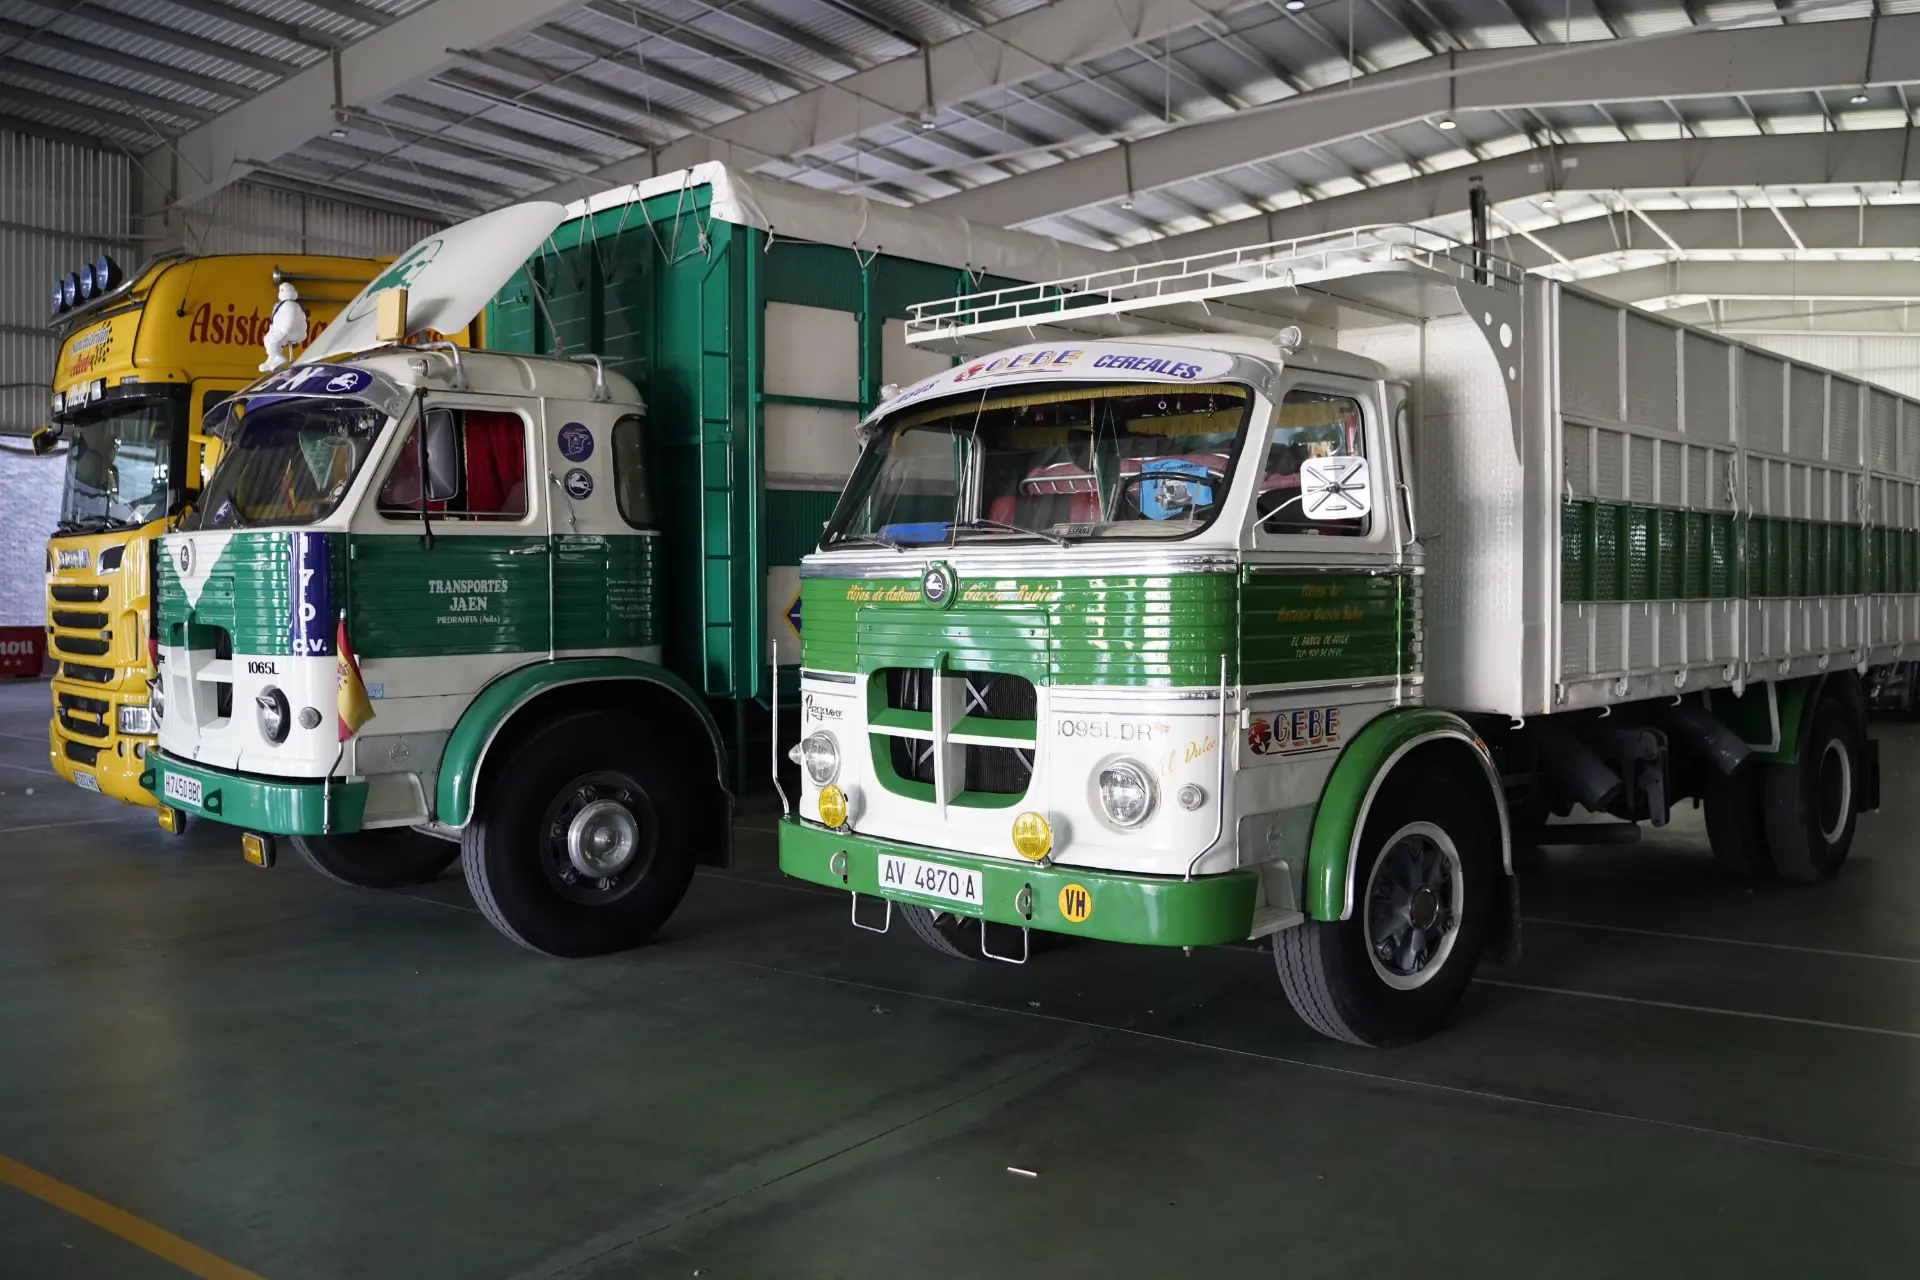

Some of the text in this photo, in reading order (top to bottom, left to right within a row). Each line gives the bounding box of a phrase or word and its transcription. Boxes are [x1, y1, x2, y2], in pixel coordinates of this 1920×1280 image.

[189, 302, 328, 349] Asisteia
[1093, 354, 1203, 380] CEREALES
[428, 579, 508, 594] TRANSPORTES
[846, 584, 870, 603] Hijos
[872, 585, 883, 601] de
[885, 584, 921, 602] Antonio
[450, 596, 488, 611] JAEN
[436, 615, 478, 624] PIEDRAHITA
[247, 661, 280, 675] 1065L
[1057, 718, 1152, 741] 1095LDR
[1272, 707, 1341, 748] GEBE
[885, 859, 976, 900] AV 4870 A
[1065, 888, 1086, 918] VH
